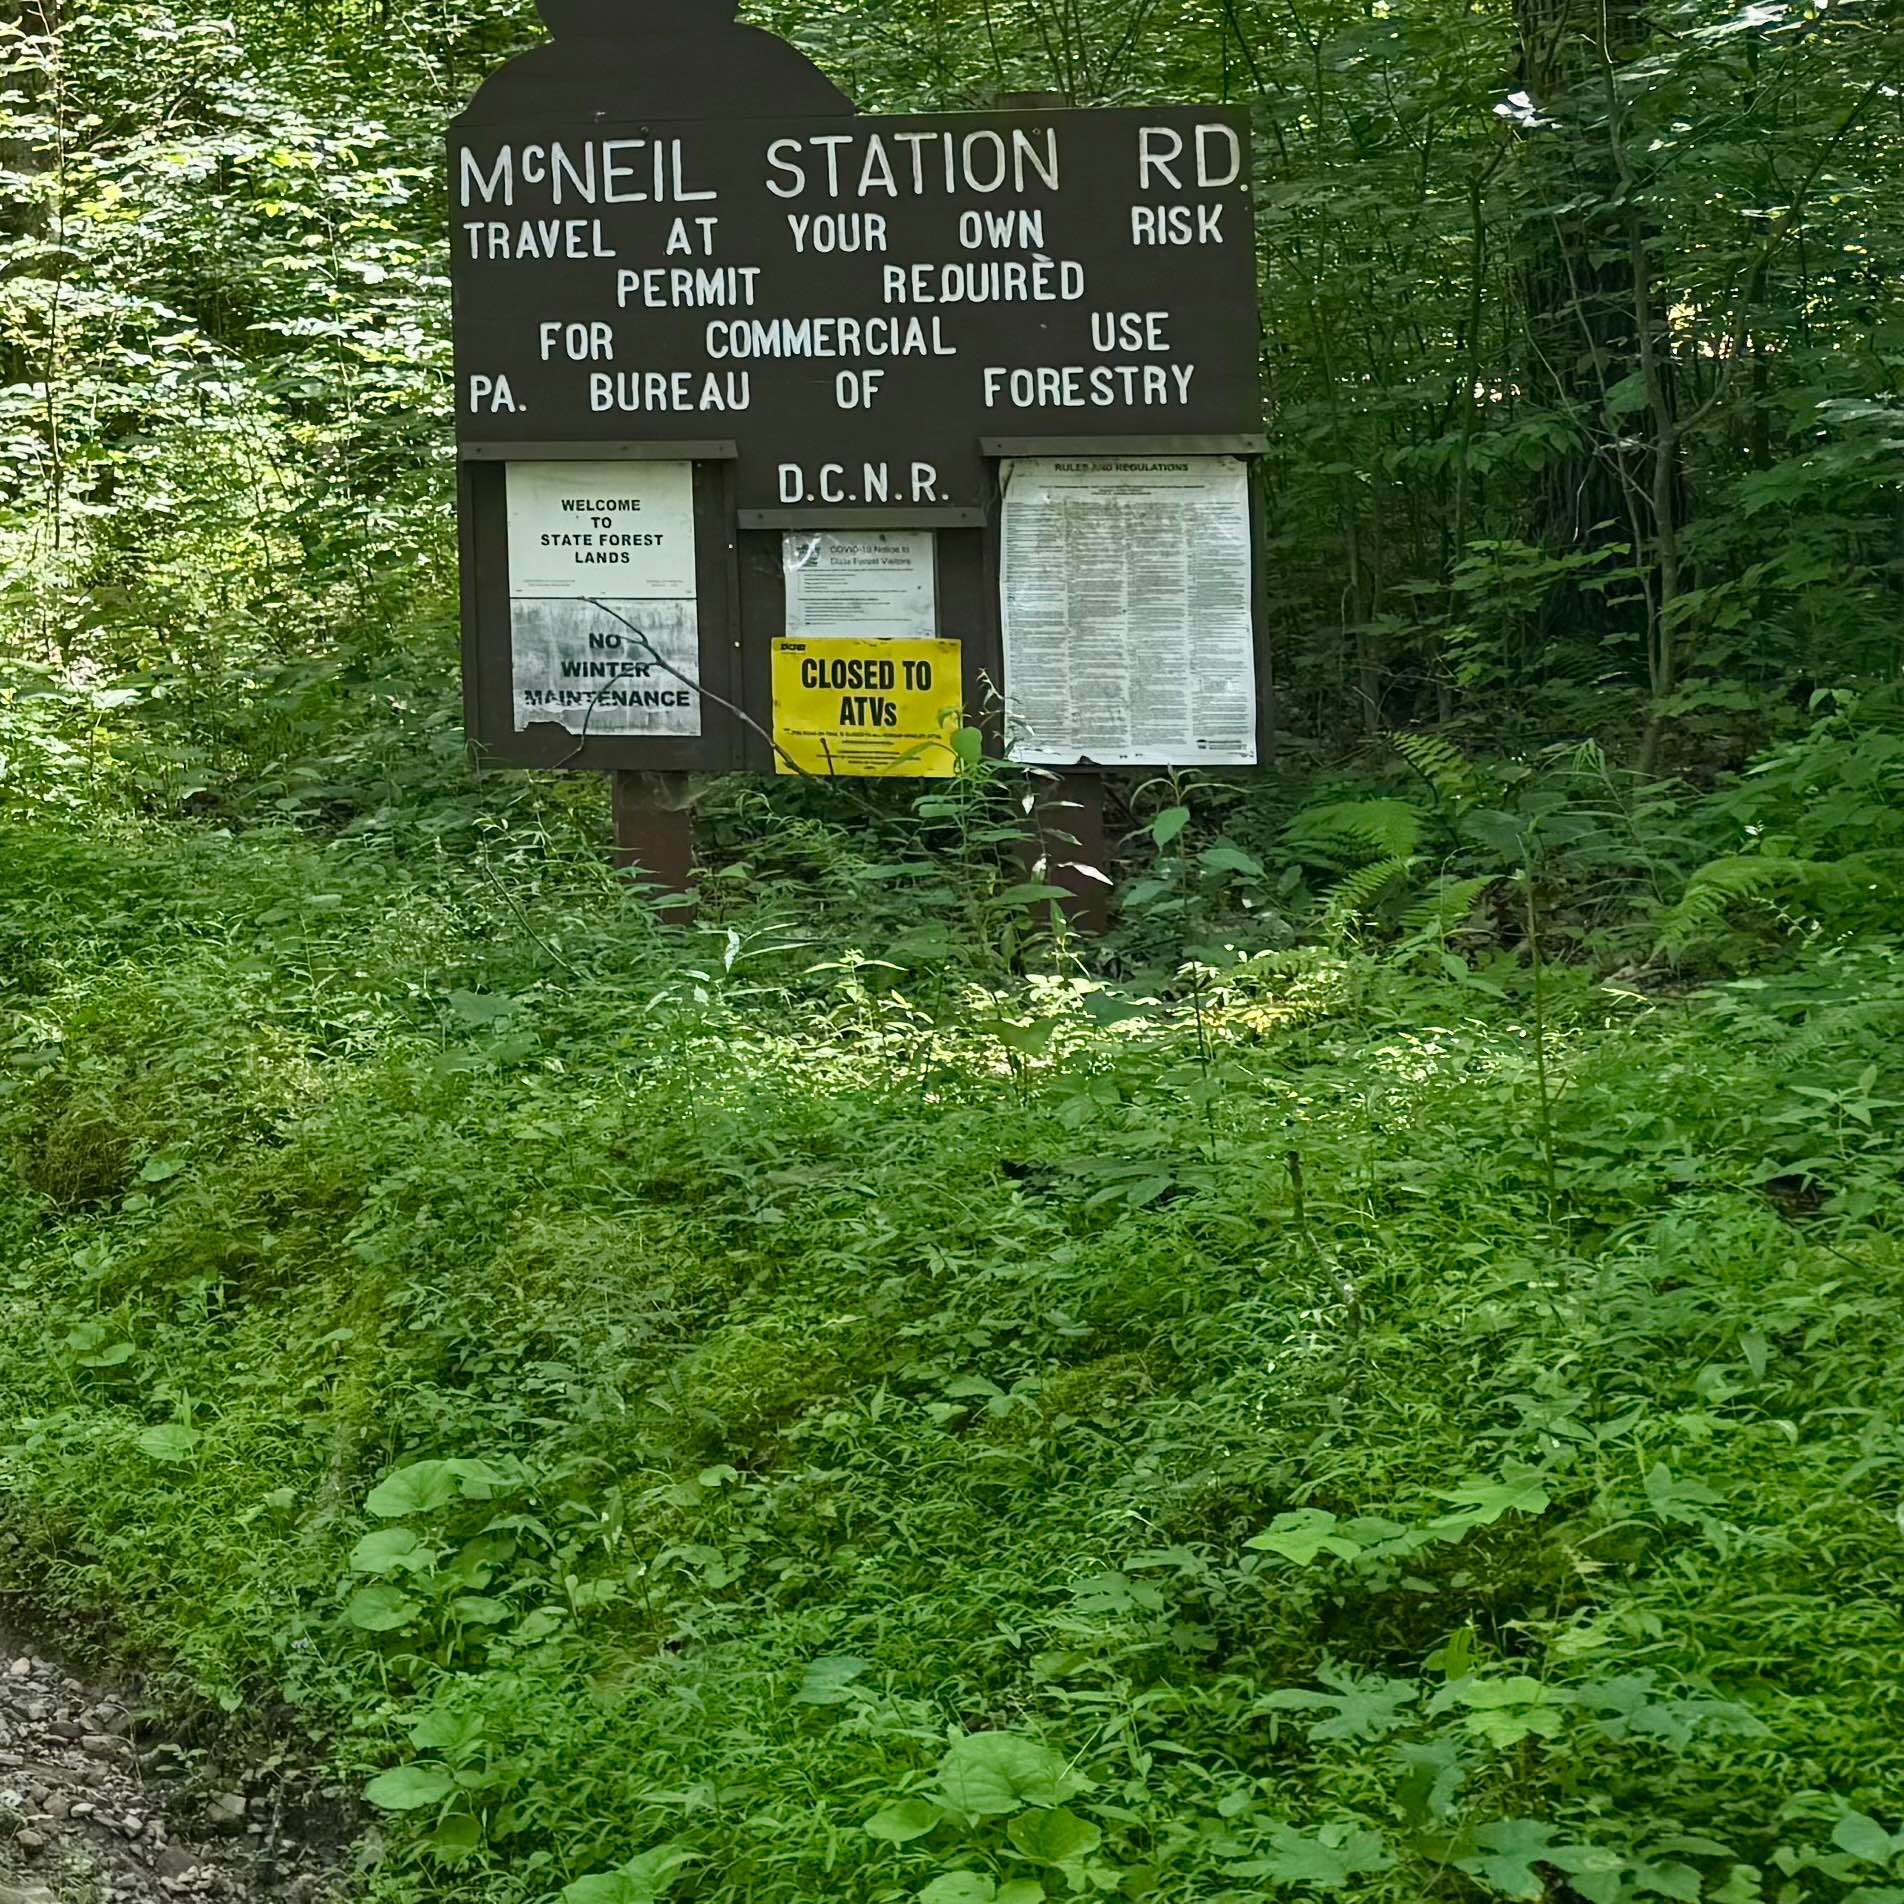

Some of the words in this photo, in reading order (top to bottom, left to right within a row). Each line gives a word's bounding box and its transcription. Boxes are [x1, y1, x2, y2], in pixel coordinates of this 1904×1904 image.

[765, 128, 1060, 198] STATION
[1138, 123, 1249, 192] RD.
[463, 218, 617, 260] TRAVEL
[665, 216, 719, 256] AT
[787, 212, 888, 253] YOUR
[959, 209, 1045, 249] OWN
[1131, 203, 1224, 246] RISK
[616, 266, 762, 308] PERMIT
[883, 256, 1086, 304] REQUIRED
[539, 321, 615, 362] FOR
[705, 315, 958, 360] COMMERCIAL
[1091, 311, 1171, 353] USE
[469, 374, 528, 414] PA.
[589, 370, 751, 413] BUREAU
[835, 369, 886, 410] OF
[983, 364, 1195, 408] FORESTRY
[1115, 462, 1189, 472] REGULATIONS
[777, 461, 951, 505] D.C.N.R.
[561, 499, 641, 511] WELCOME
[590, 516, 613, 528] TO
[540, 534, 593, 546] STATE
[599, 534, 664, 546] FOREST
[574, 551, 630, 563] LANDS
[588, 633, 622, 649] NO
[561, 661, 651, 678] WINTER
[801, 658, 896, 690] CLOSED
[902, 660, 932, 691] TO
[524, 690, 691, 707] MAINTENANCE
[839, 696, 898, 727] ATVs
